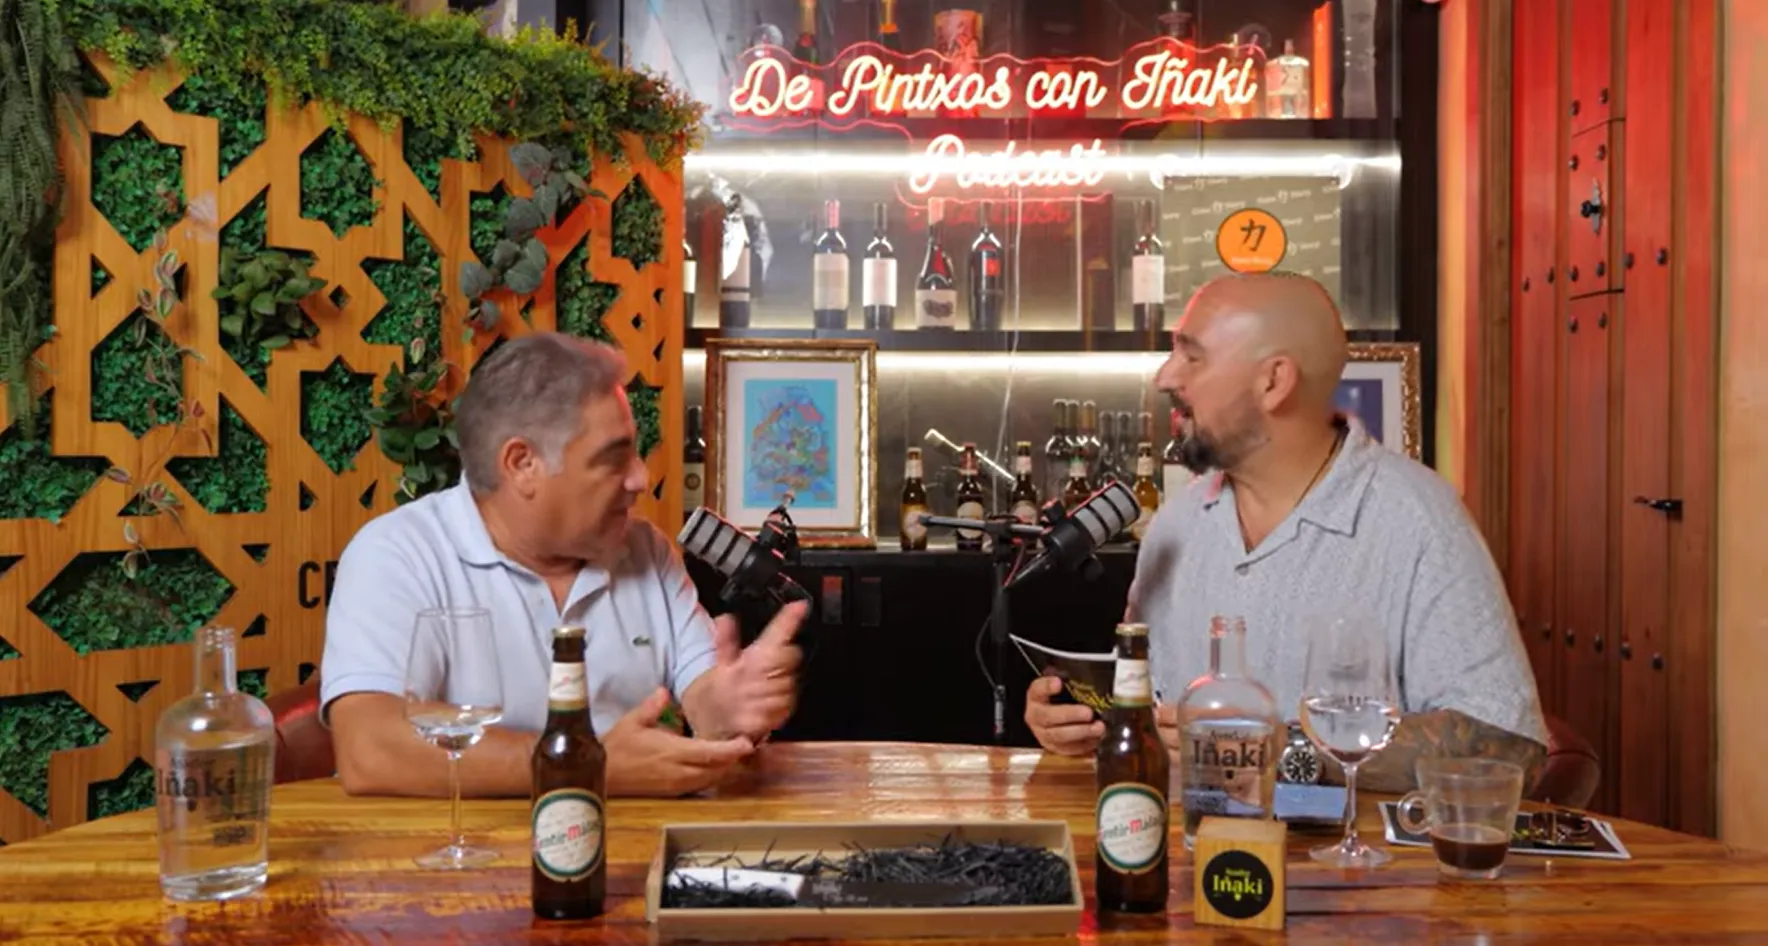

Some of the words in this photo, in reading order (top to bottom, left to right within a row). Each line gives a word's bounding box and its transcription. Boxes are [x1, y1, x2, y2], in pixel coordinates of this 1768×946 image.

[728, 57, 814, 116] De
[828, 55, 1012, 115] Pintxos
[1025, 69, 1108, 110] con
[1122, 50, 1259, 109] Iñaki
[908, 133, 1107, 194] Podcast
[1240, 217, 1267, 252] 力
[1193, 737, 1267, 767] Iñaki
[1213, 873, 1264, 896] Iñaki
